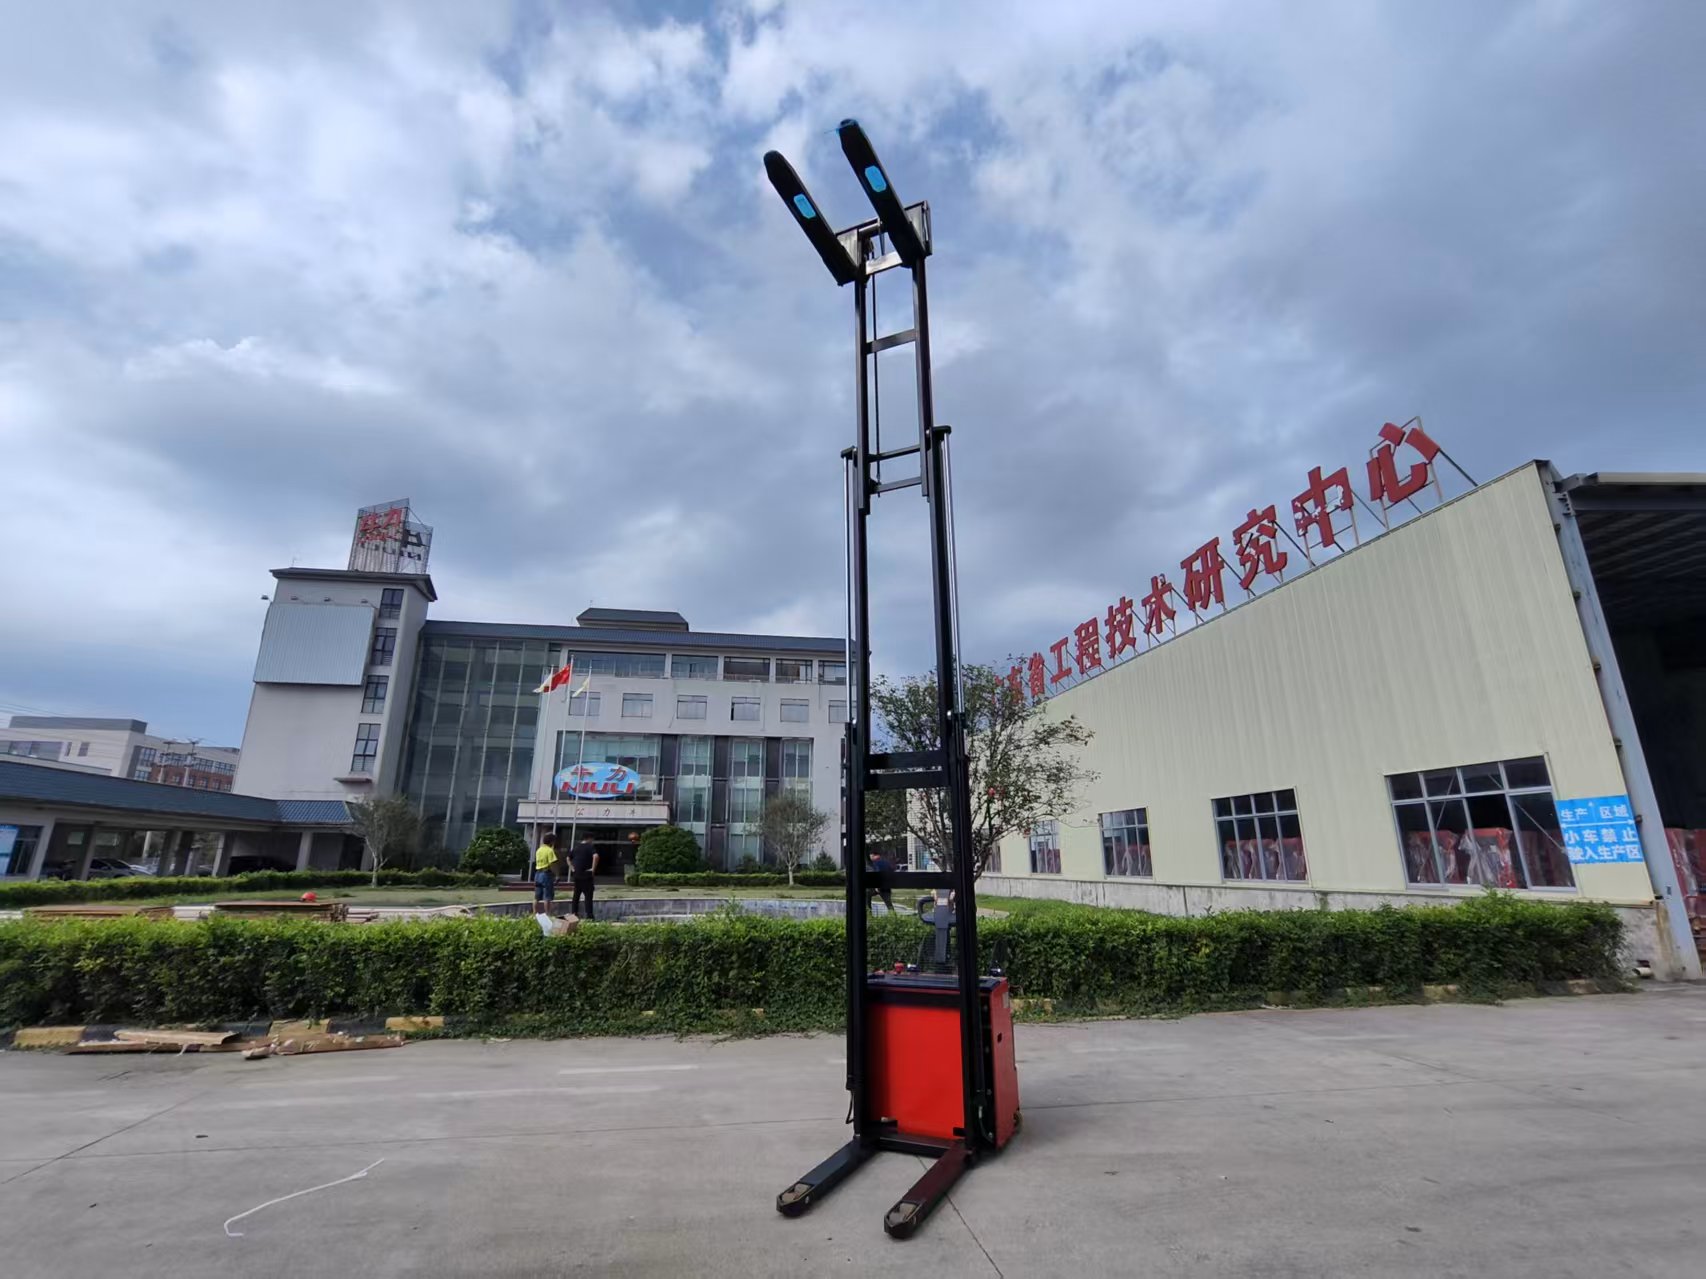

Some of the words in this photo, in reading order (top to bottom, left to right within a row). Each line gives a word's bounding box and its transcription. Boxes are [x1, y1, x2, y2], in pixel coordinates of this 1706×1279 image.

[560, 781, 634, 795] NIULI
[1564, 828, 1639, 844] 小车禁止
